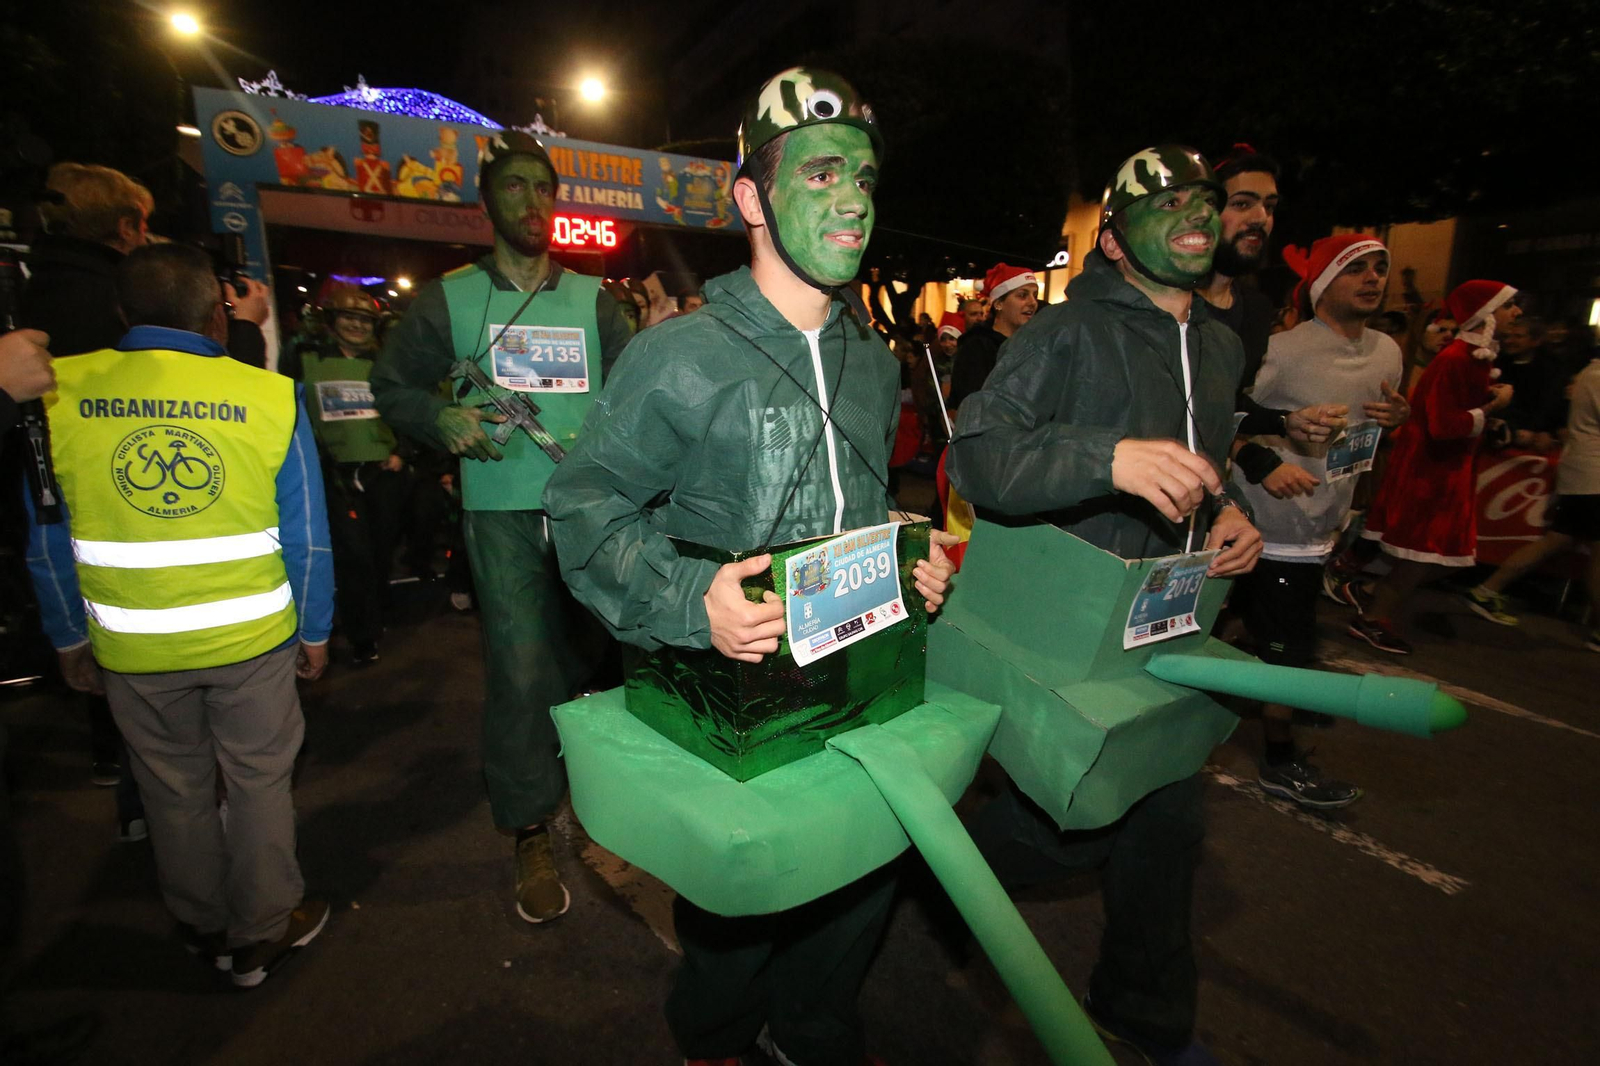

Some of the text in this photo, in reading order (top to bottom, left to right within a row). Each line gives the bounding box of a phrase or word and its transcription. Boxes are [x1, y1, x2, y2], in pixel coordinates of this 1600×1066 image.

[530, 345, 581, 362] 2135
[80, 398, 247, 423] ORGANIZACIÓN
[1348, 433, 1373, 453] 1918
[118, 430, 155, 460] CICLISTA
[165, 429, 214, 458] MARTINEZ
[208, 465, 220, 496] OLIVER
[147, 504, 198, 516] ALMERIA
[834, 553, 856, 567] CIUDAD
[857, 549, 865, 558] DE
[833, 551, 891, 599] 2039
[1163, 573, 1203, 600] 2013
